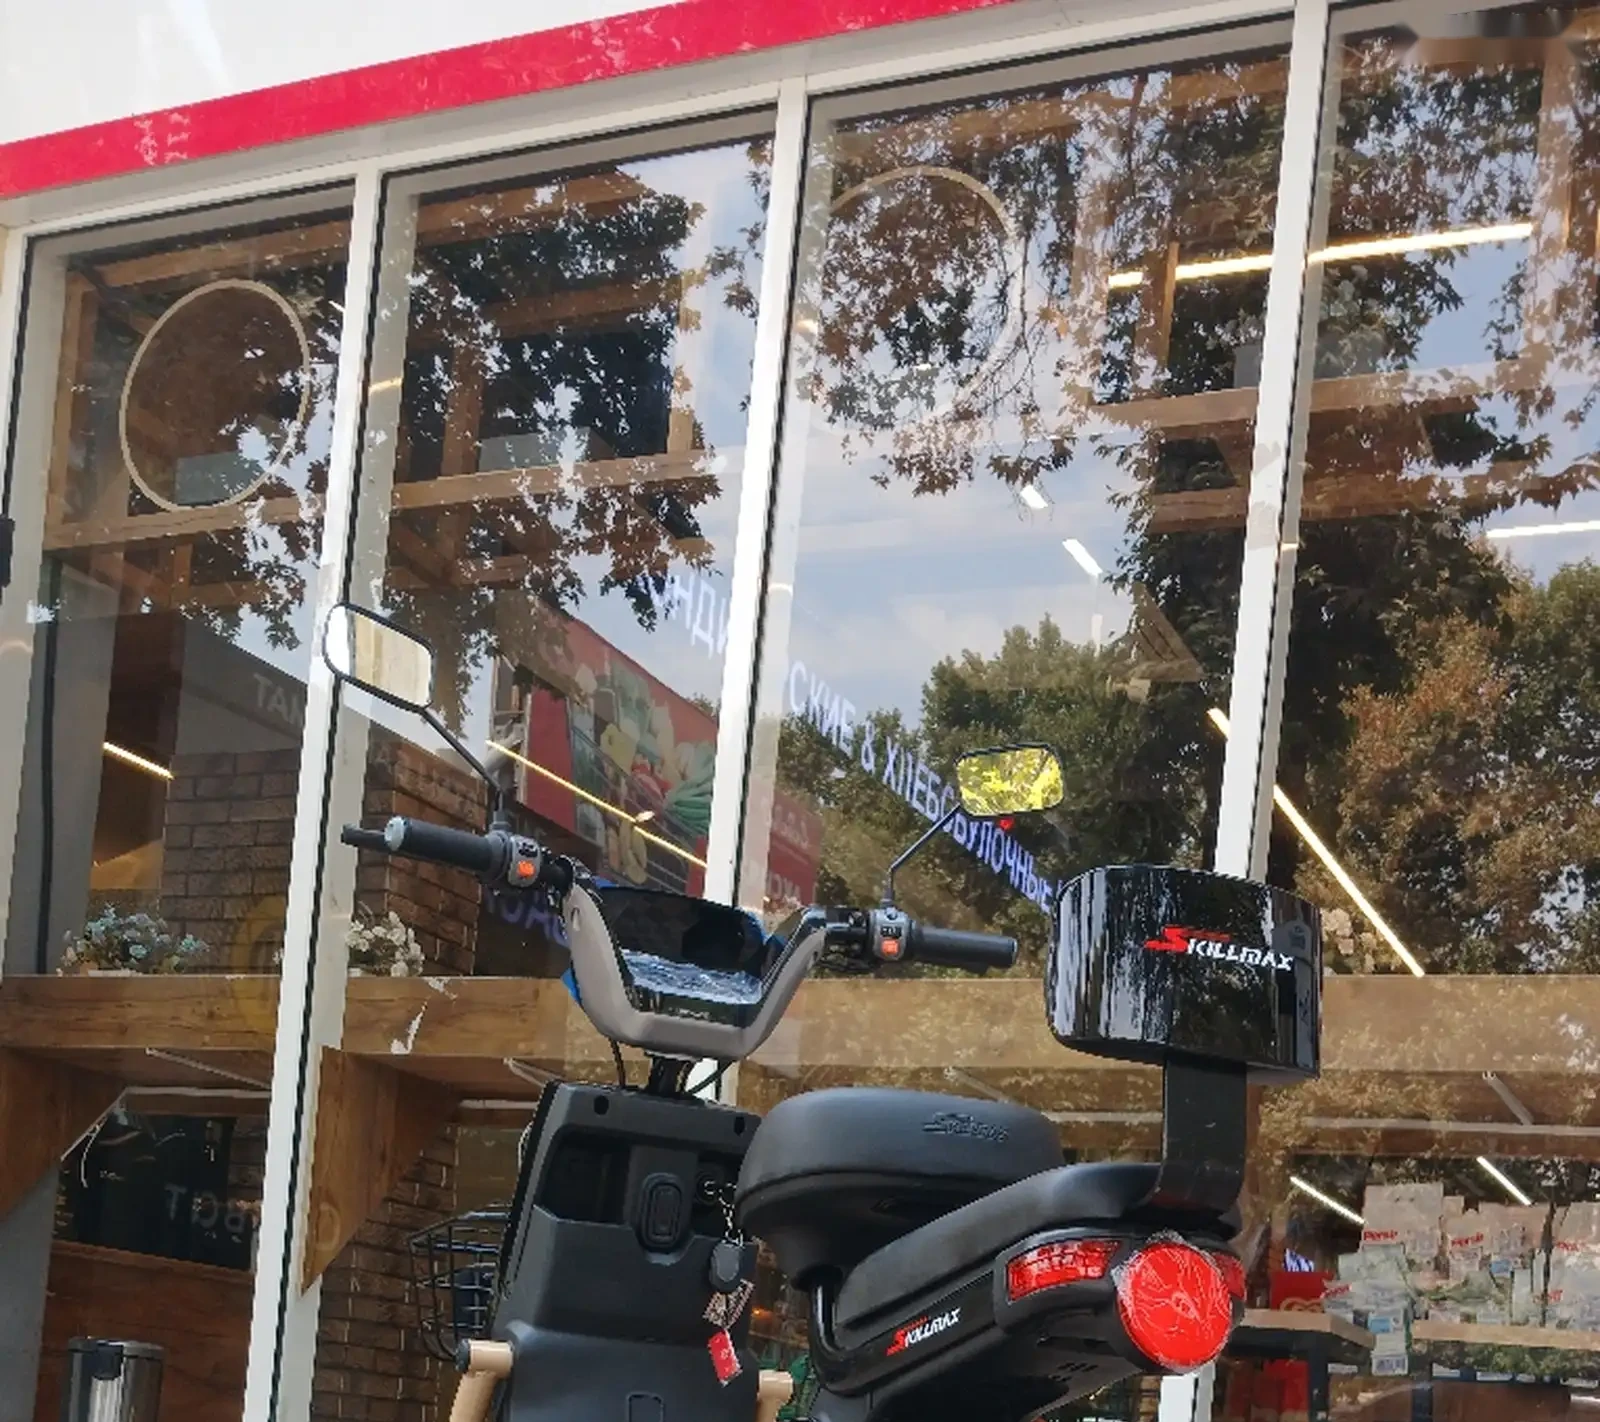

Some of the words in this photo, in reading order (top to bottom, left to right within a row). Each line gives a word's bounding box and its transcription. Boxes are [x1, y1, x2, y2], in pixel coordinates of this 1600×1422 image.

[861, 720, 876, 776] &
[1143, 924, 1295, 971] SKILLMAX
[884, 1307, 962, 1357] SKILLMAX
